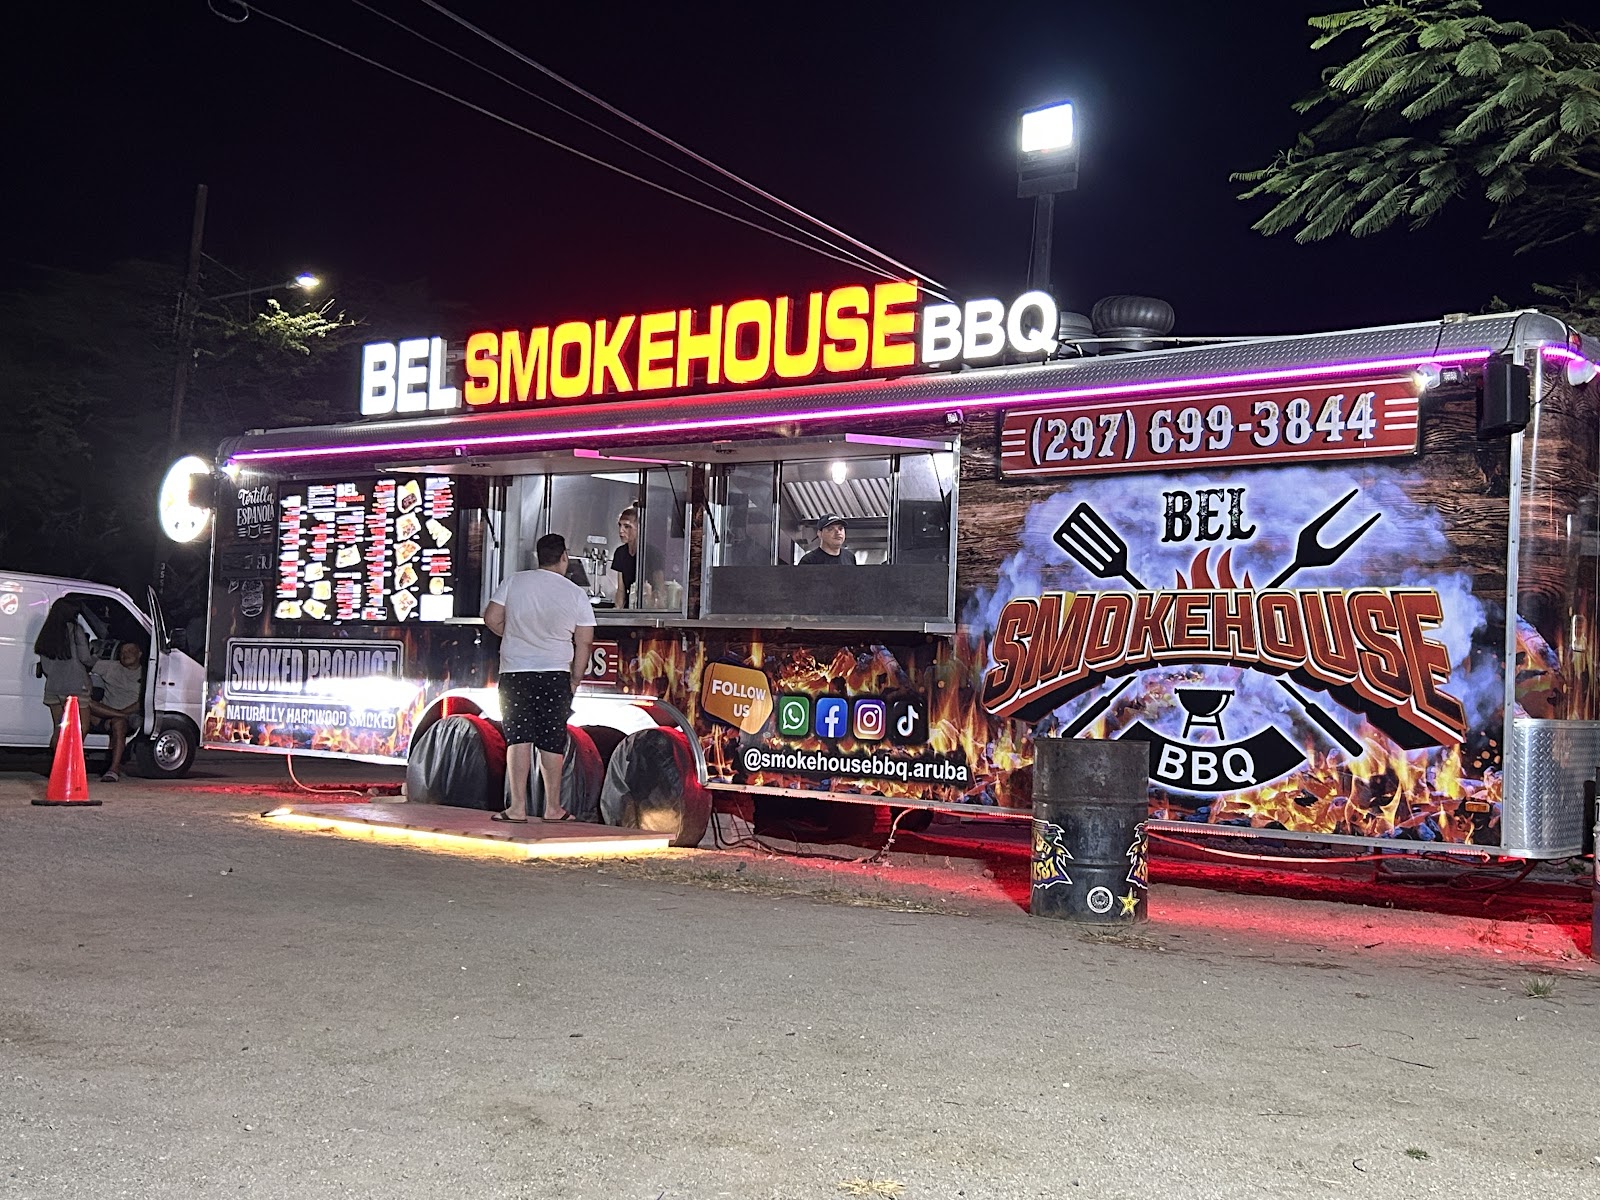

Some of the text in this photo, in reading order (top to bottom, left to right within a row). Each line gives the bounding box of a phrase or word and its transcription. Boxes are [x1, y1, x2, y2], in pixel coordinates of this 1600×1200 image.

[361, 281, 1060, 415] BEL SMOKEHOUSE BBQ
[1032, 392, 1376, 465] (297) 699-3844
[238, 486, 274, 506] Tortilla
[1161, 487, 1256, 543] BEL
[232, 647, 303, 692] SMOKED
[981, 587, 1467, 747] SMOKEHOUSE
[712, 680, 766, 700] FOLLOW
[733, 703, 750, 717] US
[226, 704, 396, 729] NATURALLY HARDWOOD SMOKED
[744, 748, 968, 781] @smokehousebbq.aruba
[1156, 745, 1257, 786] BBQ
